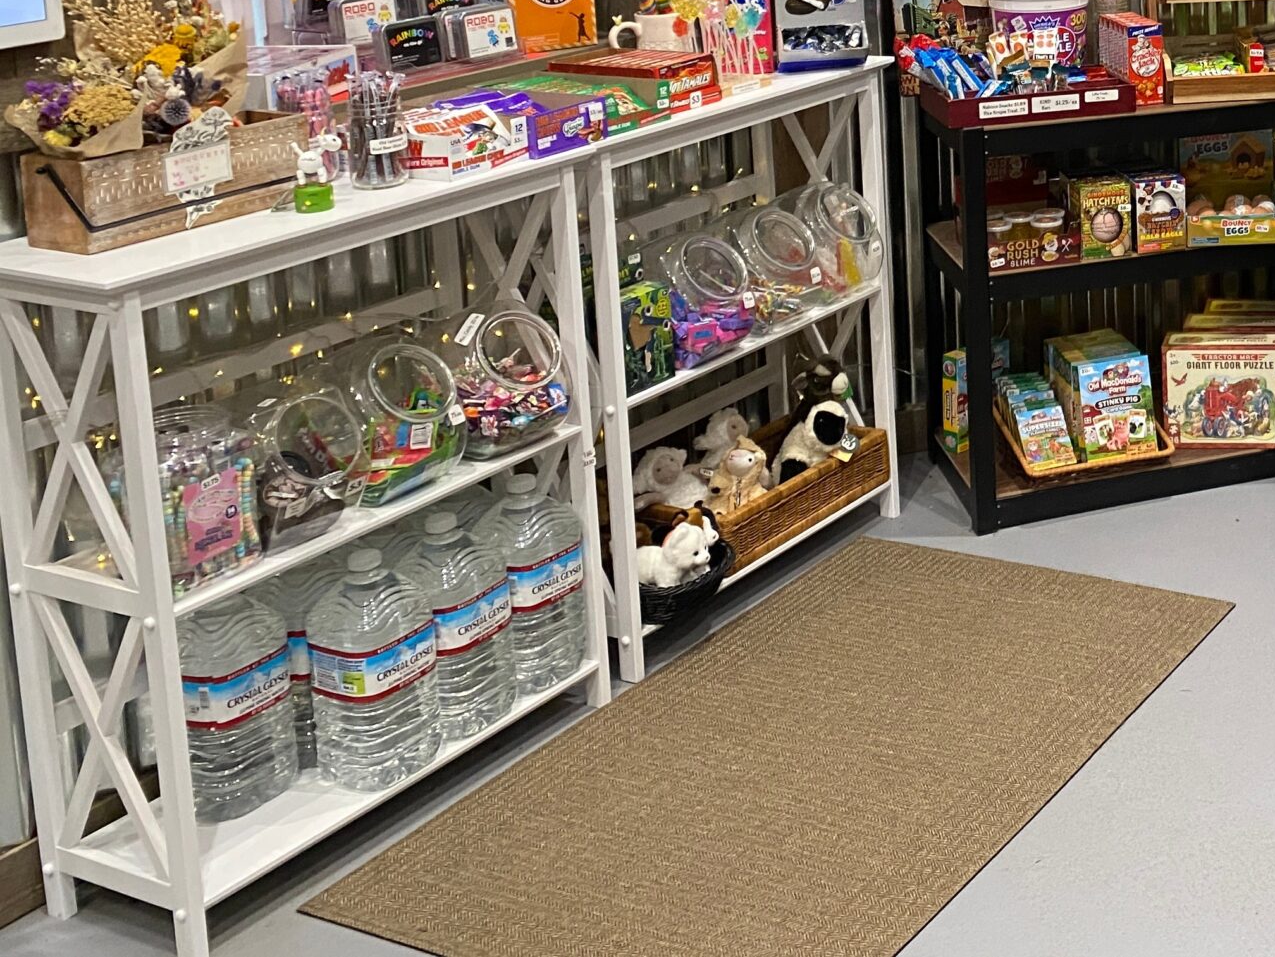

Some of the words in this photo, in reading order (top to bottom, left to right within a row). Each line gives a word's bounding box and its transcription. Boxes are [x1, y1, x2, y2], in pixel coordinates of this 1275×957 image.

[344, 2, 375, 15] ROBO
[466, 15, 495, 27] ROBO
[389, 28, 434, 47] RAINBOW
[516, 124, 523, 133] 12
[1226, 227, 1248, 235] EGGS
[1007, 240, 1039, 251] GOLD
[1007, 250, 1039, 260] RUSH
[1010, 259, 1035, 267] SLIME
[1187, 361, 1211, 370] GIANT
[1215, 361, 1241, 370] FLOOR
[1244, 361, 1274, 370] PUZZLE
[1088, 382, 1099, 391] Old
[1109, 386, 1125, 394] Farm
[1098, 397, 1124, 408] STINKY
[1125, 395, 1139, 404] PIG
[532, 575, 559, 595] CRYSTAL
[458, 615, 487, 636] CRYSTAL
[377, 658, 409, 682] CRYSTAL
[227, 685, 262, 709] CRYSTAL
